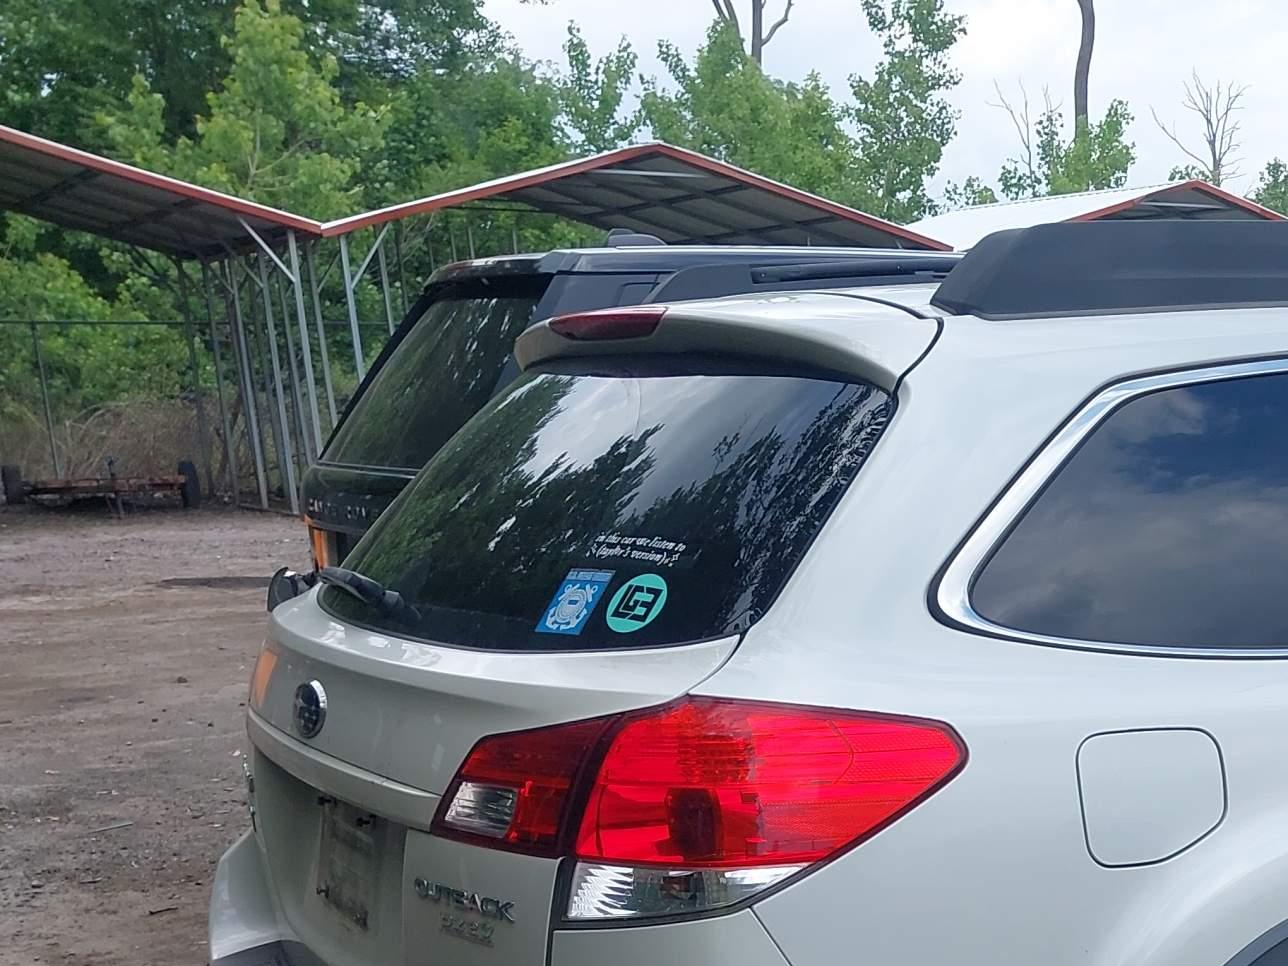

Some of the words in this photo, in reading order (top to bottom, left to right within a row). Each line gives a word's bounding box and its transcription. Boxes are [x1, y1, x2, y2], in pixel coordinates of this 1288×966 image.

[605, 531, 622, 544] this
[620, 536, 636, 545] car
[648, 536, 675, 551] listen
[674, 542, 687, 552] to
[414, 878, 516, 923] OUTBACK
